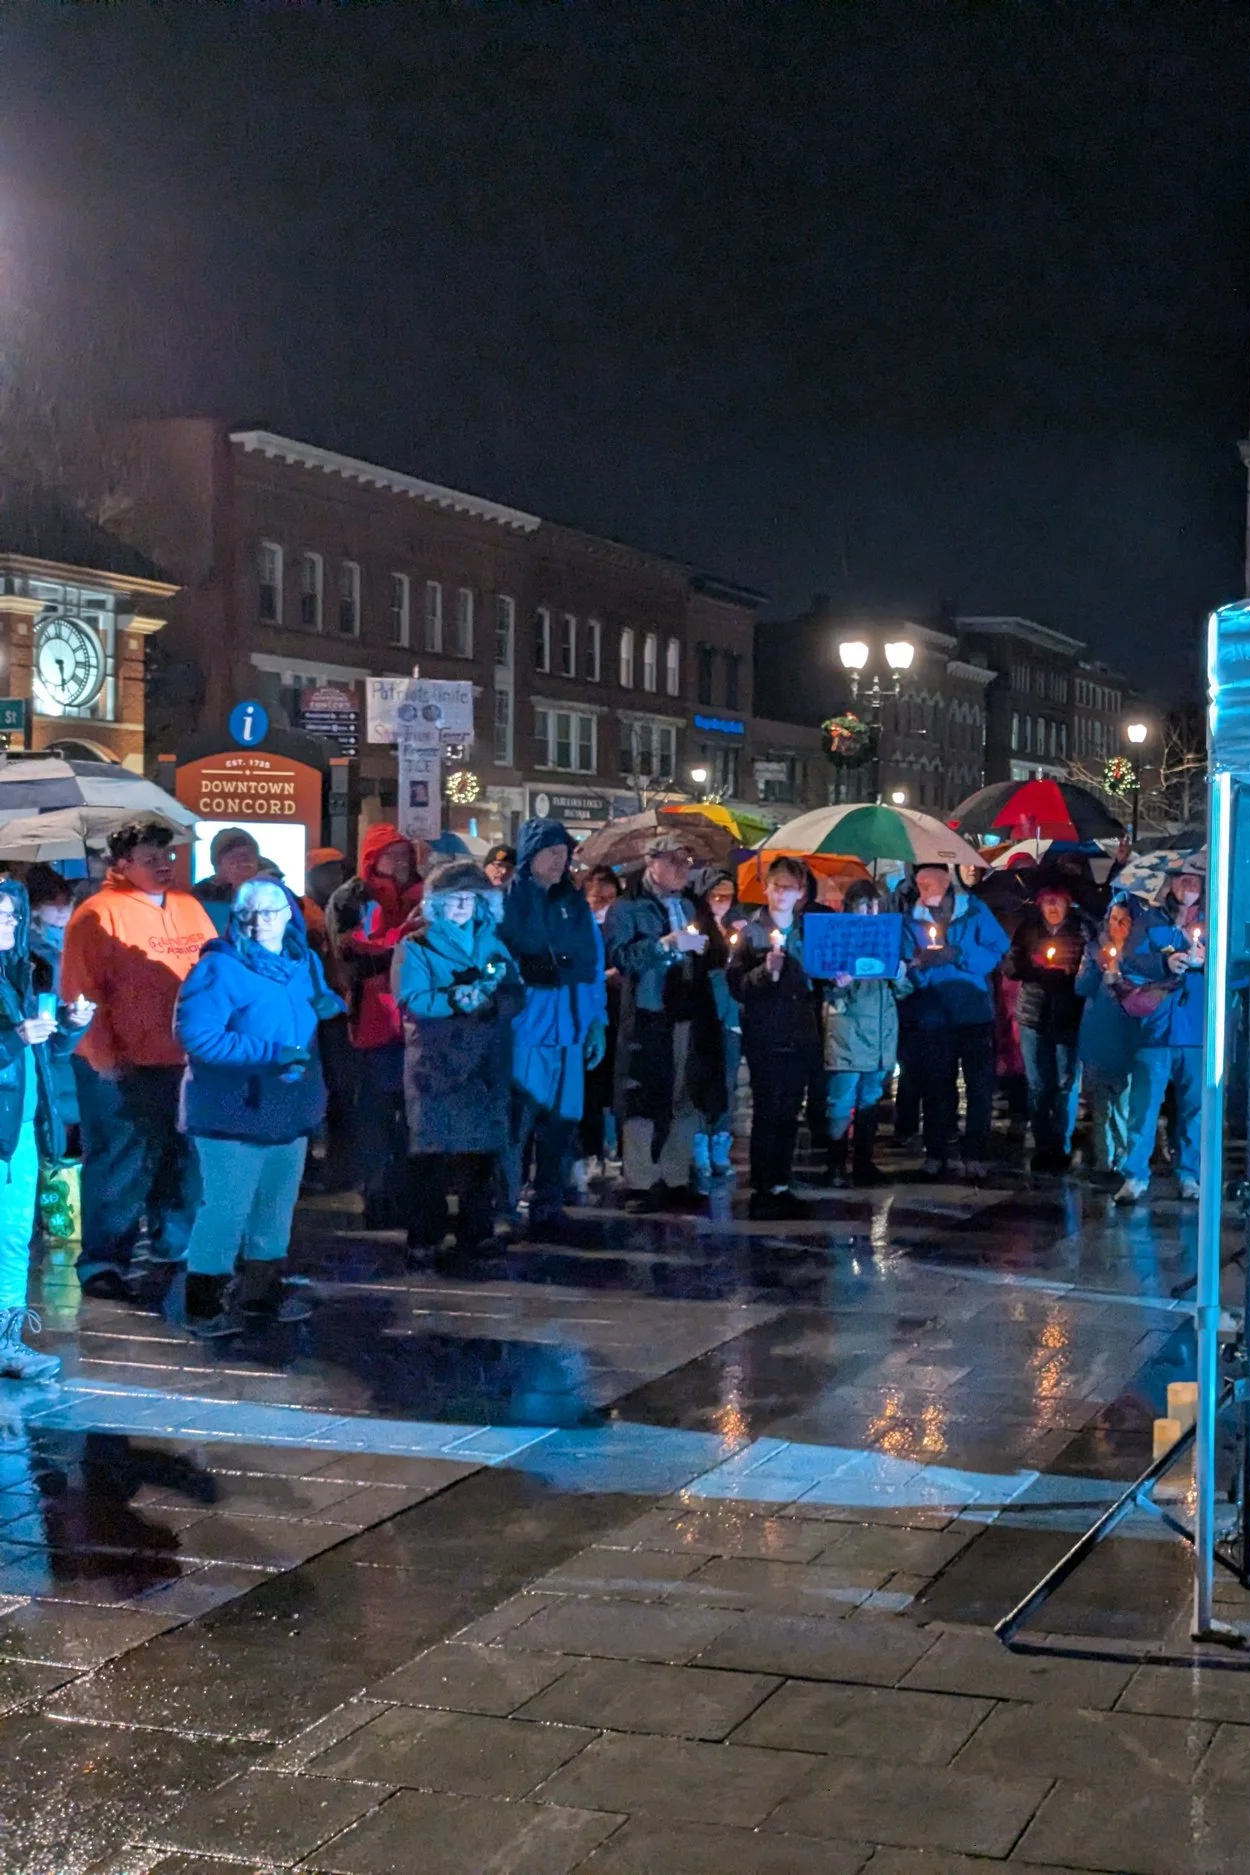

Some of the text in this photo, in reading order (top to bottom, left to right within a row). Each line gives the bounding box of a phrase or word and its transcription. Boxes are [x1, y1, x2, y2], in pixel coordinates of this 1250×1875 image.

[5, 710, 17, 724] St
[225, 759, 246, 768] EST.
[201, 780, 295, 795] DOWNTOWN
[199, 798, 296, 814] CONCORD
